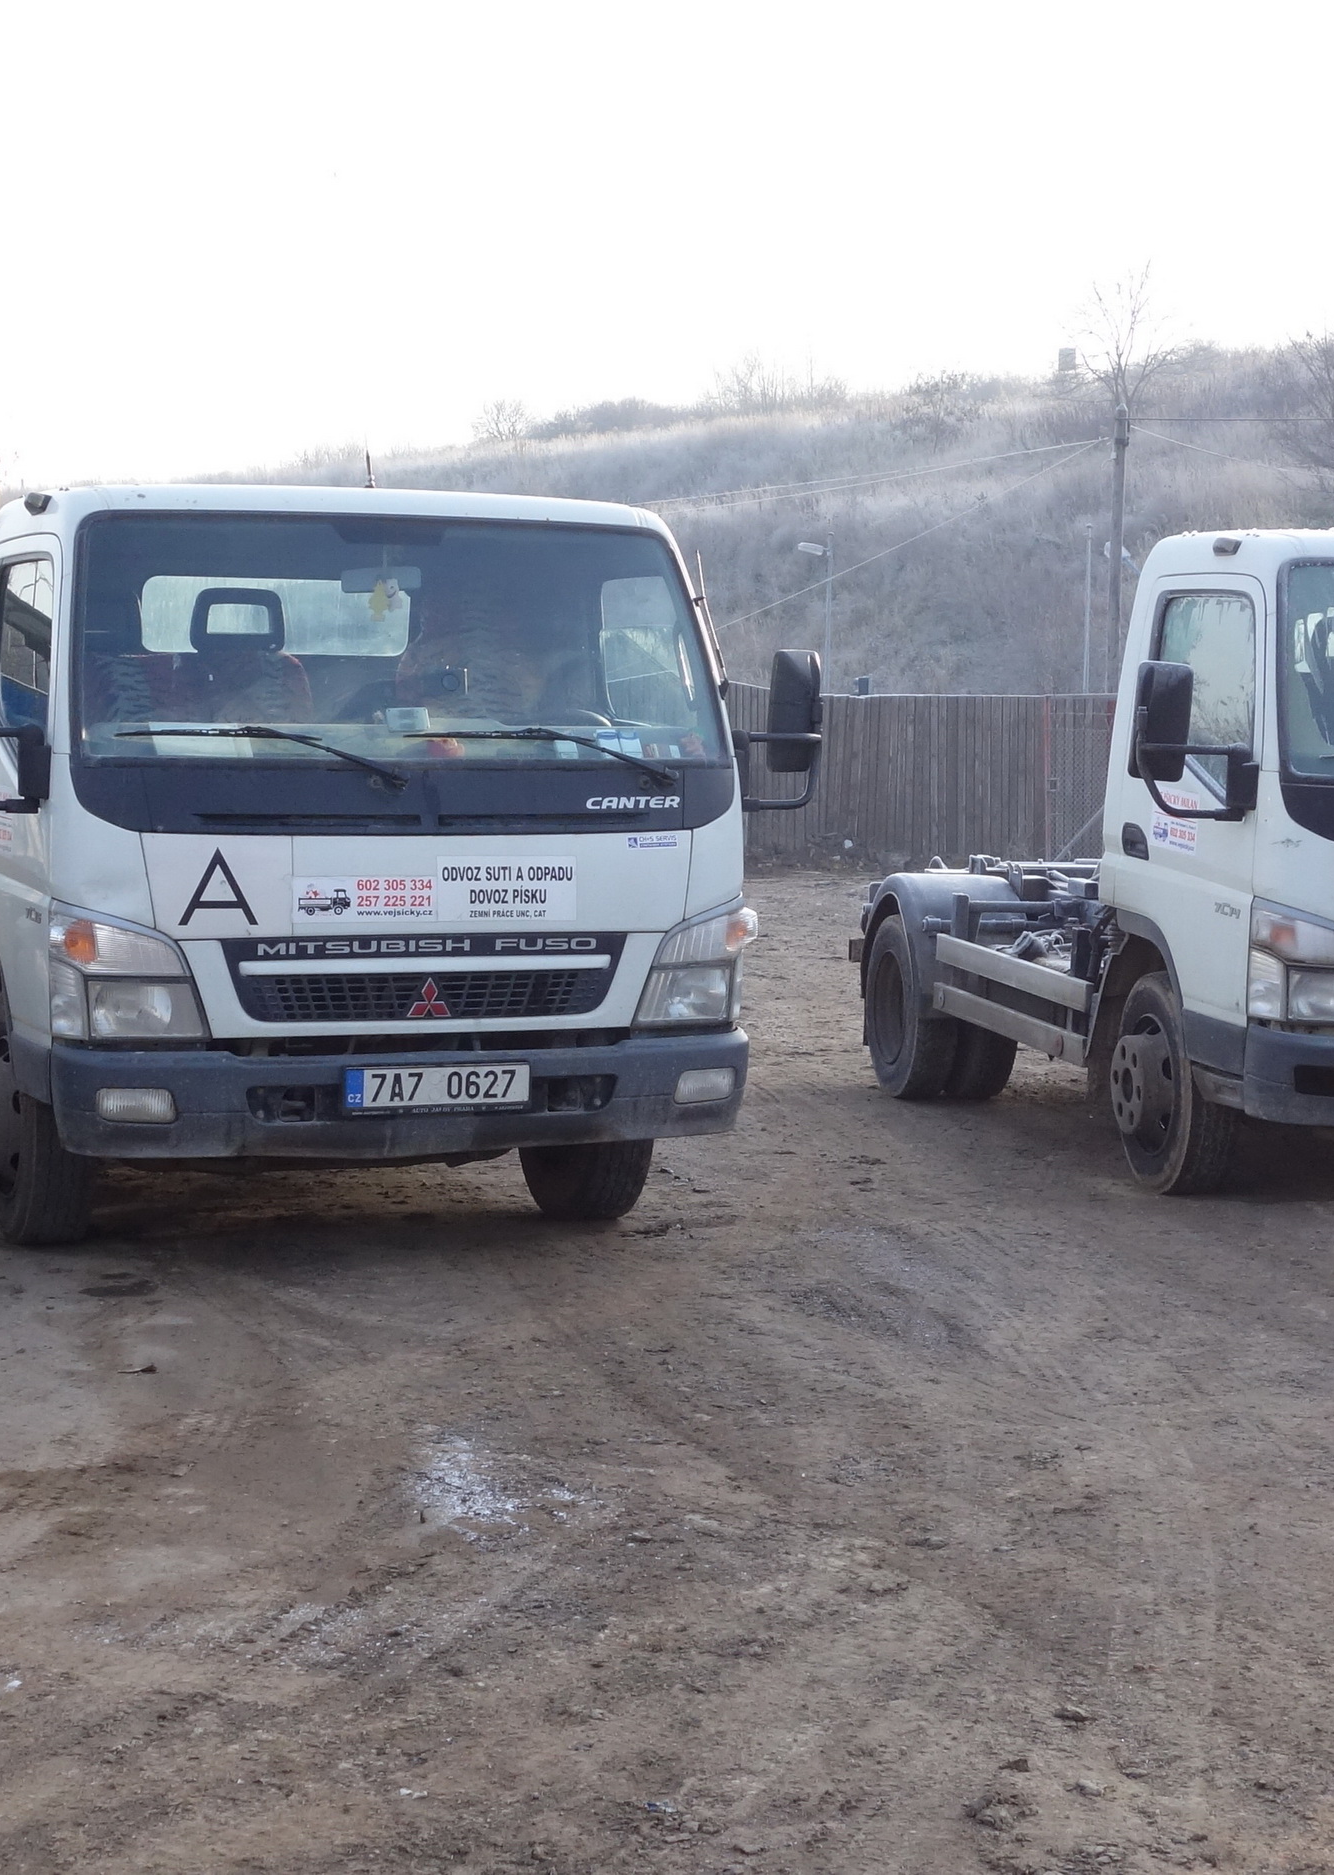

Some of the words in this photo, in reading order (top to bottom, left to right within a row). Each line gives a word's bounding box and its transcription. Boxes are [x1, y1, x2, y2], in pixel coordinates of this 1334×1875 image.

[586, 796, 680, 810] CANTER
[442, 866, 482, 882] ODVOZ
[485, 866, 512, 882] SUTI
[516, 866, 524, 881] A
[528, 865, 573, 881] ODPADU
[177, 846, 259, 926] A
[356, 879, 380, 891] 602
[383, 879, 407, 891] 305
[410, 879, 433, 891] 334
[357, 895, 380, 907] 257
[383, 895, 407, 907] 225
[410, 895, 432, 907] 221
[469, 888, 509, 905] DOVOZ
[512, 885, 547, 905] PÍSKU
[356, 908, 433, 917] www.vejsicky.cz
[469, 909, 491, 918] ZEMNÍ
[492, 909, 514, 918] PRÁCE
[533, 909, 547, 917] CAT
[257, 939, 470, 956] MITSUBISH
[495, 938, 597, 951] FUSO
[371, 1072, 423, 1102] 7A7
[447, 1069, 517, 1099] 0627
[347, 1093, 361, 1103] CZ
